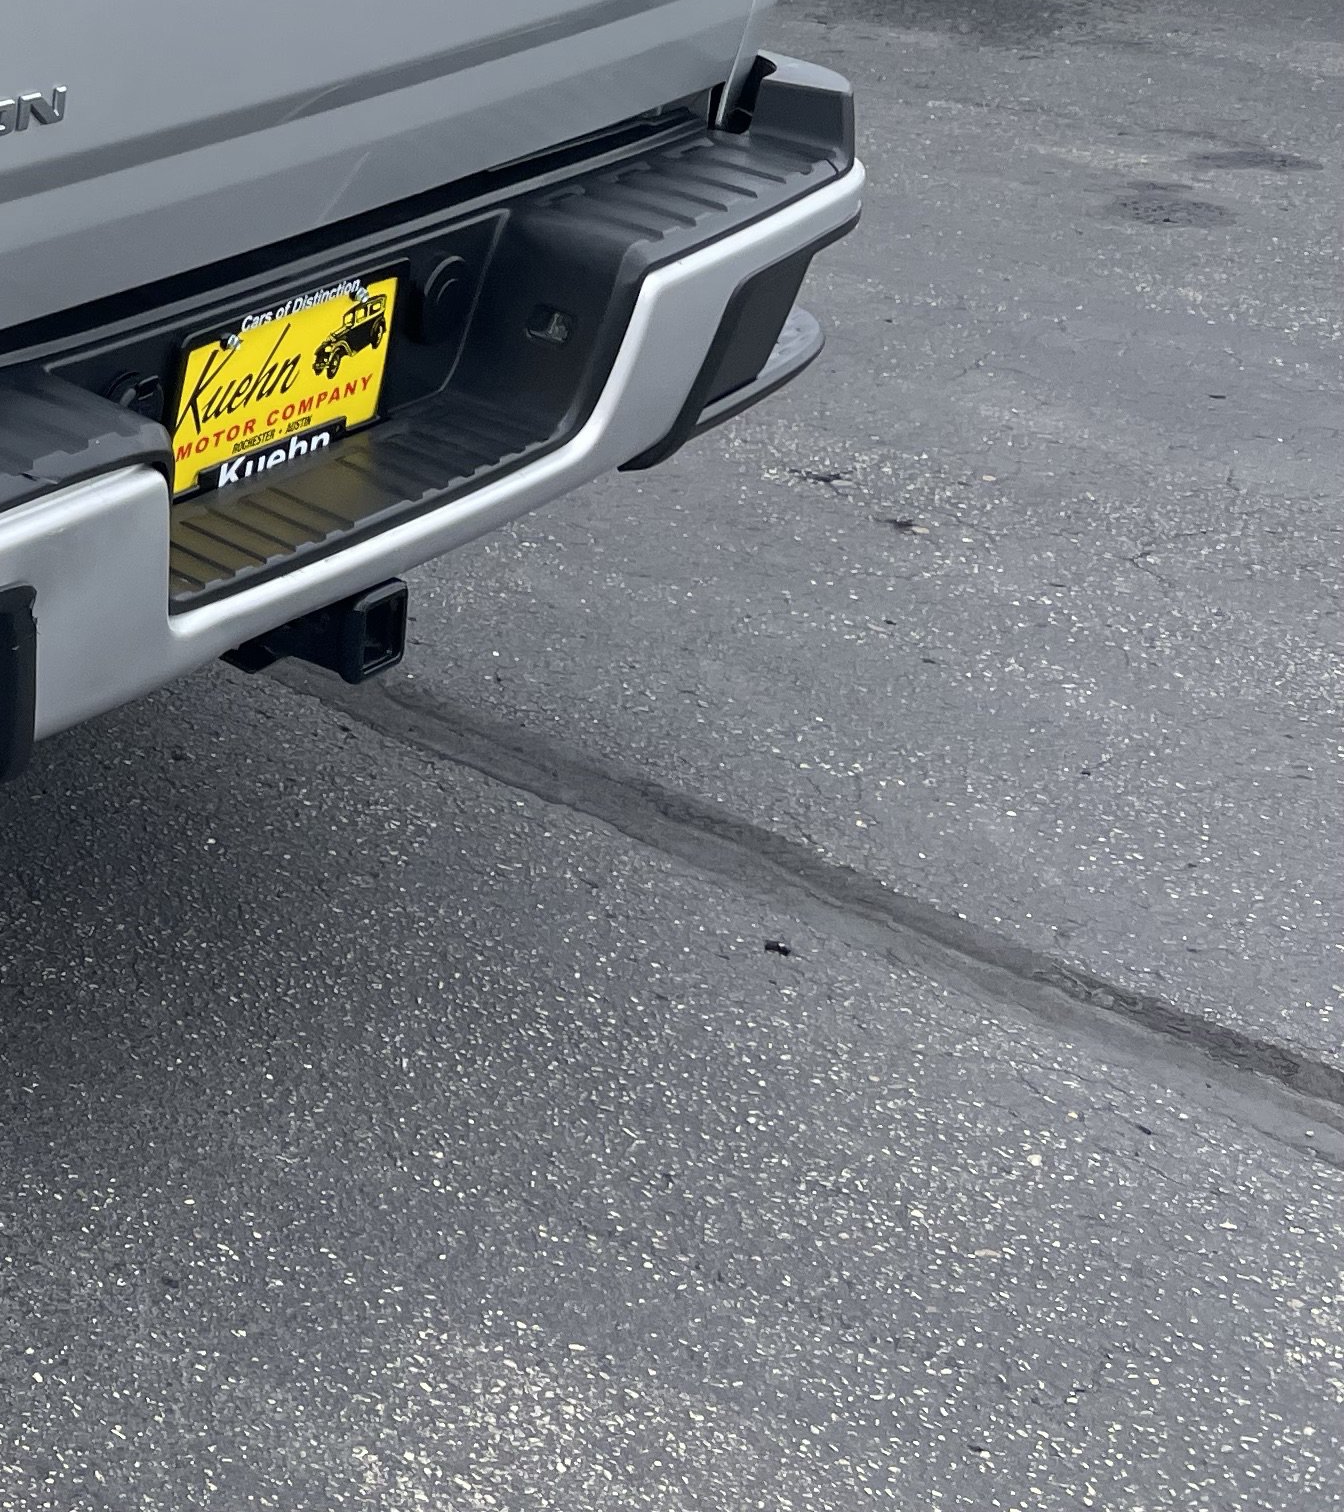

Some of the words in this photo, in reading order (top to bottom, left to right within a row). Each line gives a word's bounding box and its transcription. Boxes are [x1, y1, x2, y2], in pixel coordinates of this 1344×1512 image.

[241, 311, 273, 332] Cars
[275, 301, 292, 320] of
[291, 279, 361, 314] Distinction
[173, 323, 301, 435] Kuehn
[175, 418, 257, 462] MOTOR
[266, 373, 373, 427] COMPANY
